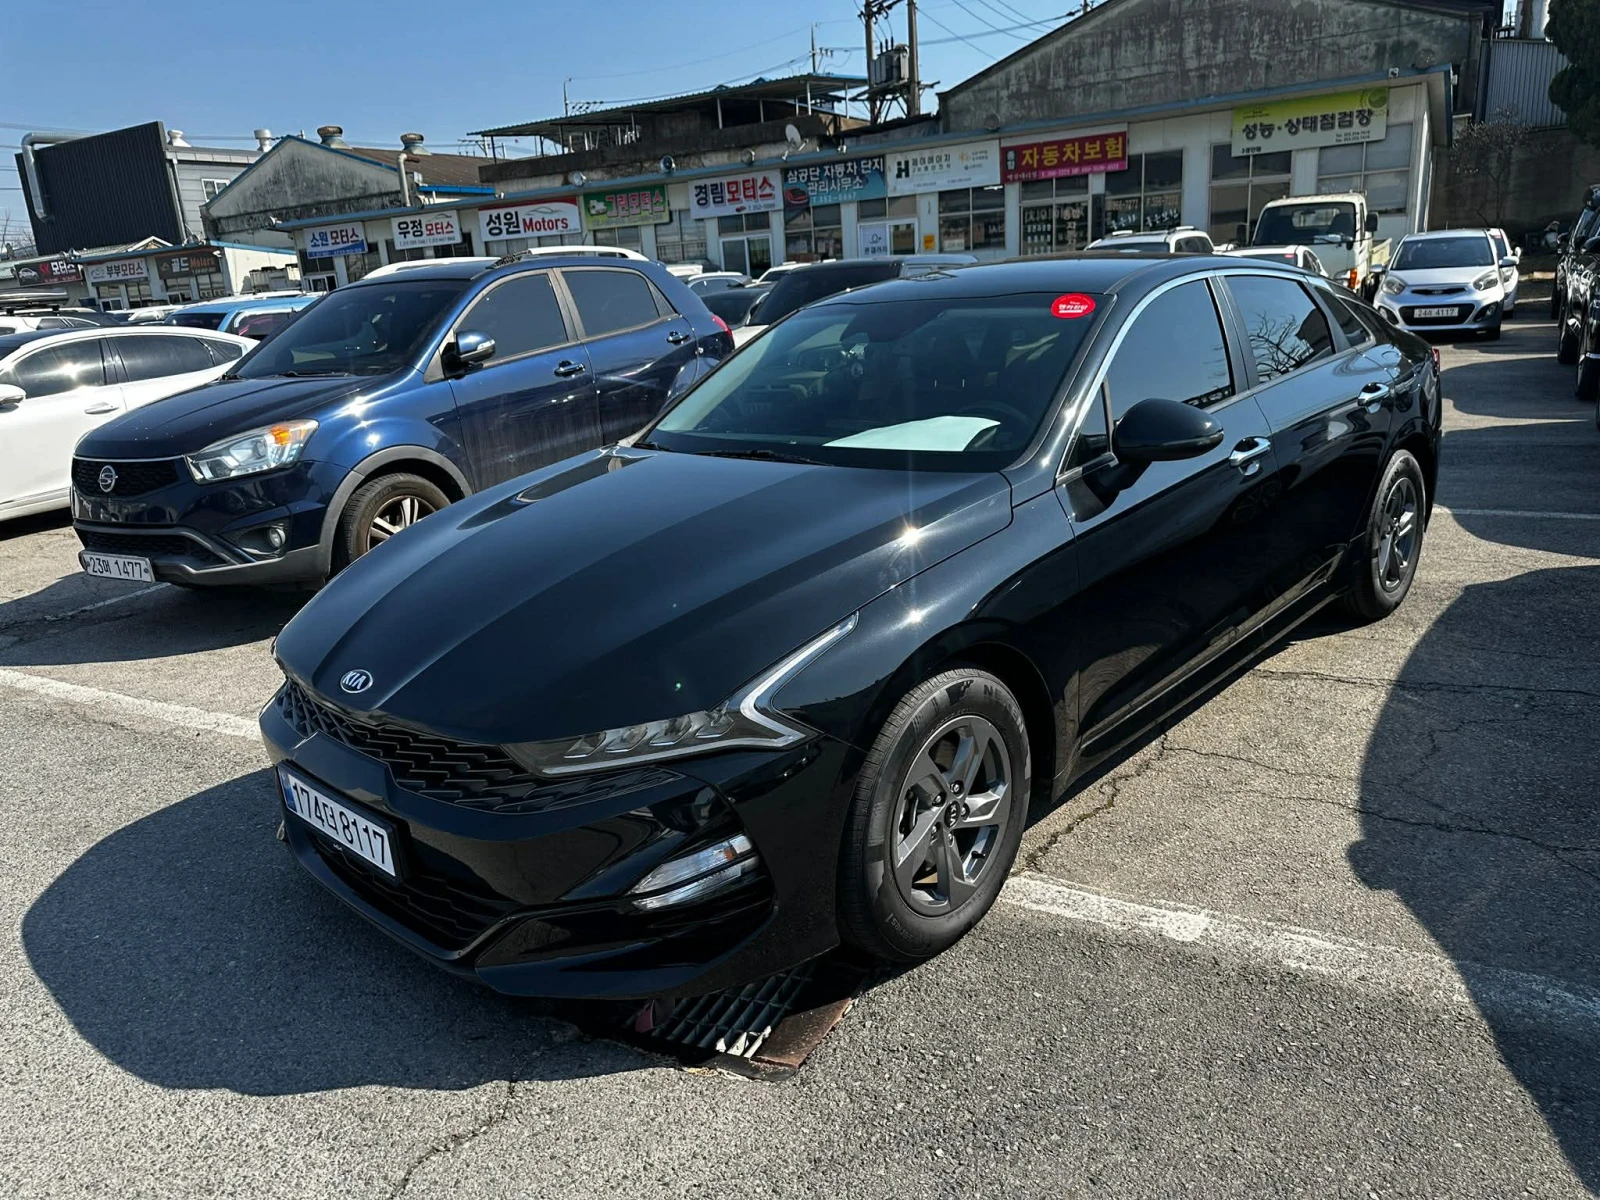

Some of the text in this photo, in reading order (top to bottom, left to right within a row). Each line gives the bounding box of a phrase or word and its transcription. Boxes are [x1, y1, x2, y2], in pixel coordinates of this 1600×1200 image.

[1021, 136, 1123, 168] 자동차보험
[787, 157, 884, 184] 삼공단 자동차 단지
[807, 176, 864, 196] 관리사무소
[397, 219, 454, 239] 우정 모터스
[486, 211, 522, 236] 성원
[522, 217, 569, 234] Motors
[310, 227, 360, 248] 소원 모터스
[50, 260, 77, 275] 모터스
[114, 559, 142, 579] 1477
[342, 671, 367, 689] KIA
[292, 781, 385, 865] 174더 8117
[949, 804, 957, 827] KIA
